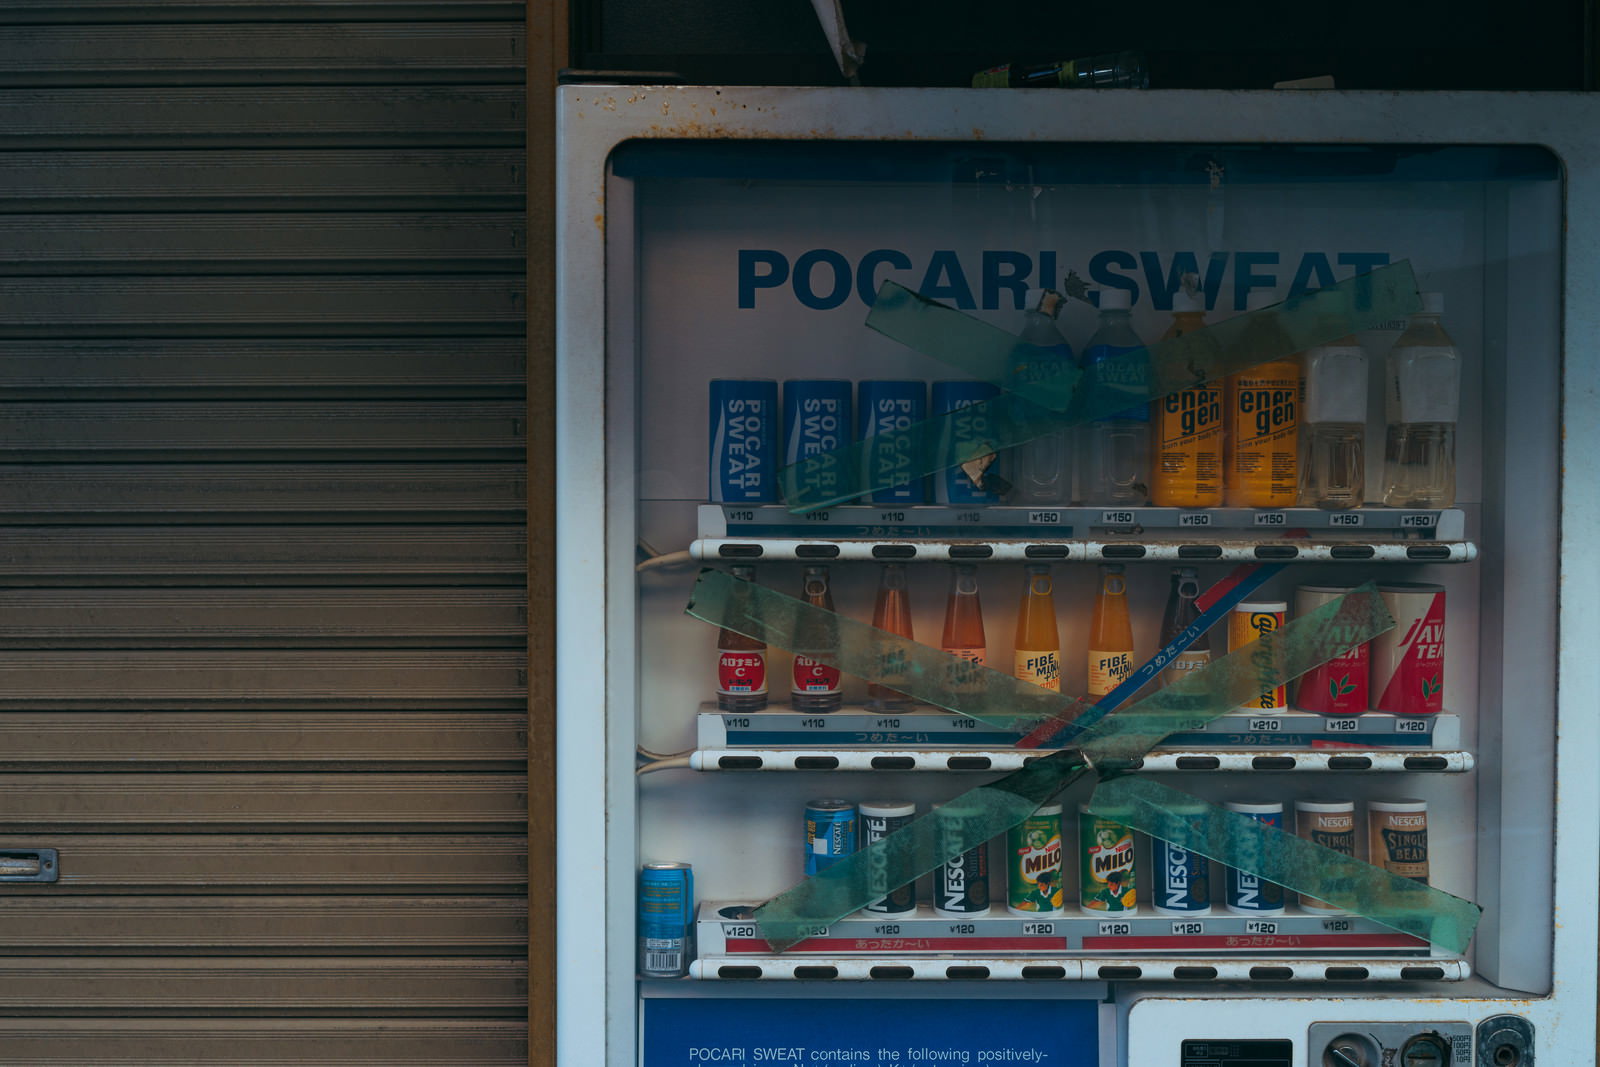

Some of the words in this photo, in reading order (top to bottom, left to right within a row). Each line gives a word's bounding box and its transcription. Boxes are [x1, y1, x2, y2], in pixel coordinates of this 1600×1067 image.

[738, 249, 1058, 311] POCARI
[1166, 391, 1217, 413] ener
[1240, 391, 1292, 413] ener
[1182, 402, 1219, 436] gen
[1256, 402, 1293, 436] gen
[728, 399, 745, 489] SWEAT
[745, 399, 761, 497] POCARI
[804, 398, 821, 489] SWEAT
[820, 398, 837, 497] POCARI
[879, 398, 896, 489] SWEAT
[895, 399, 912, 496] POCARI
[730, 511, 753, 521] ¥110
[806, 511, 829, 521] ¥110
[882, 512, 904, 522] ¥110
[1032, 512, 1058, 522] ¥150
[1106, 512, 1132, 522] ¥150
[1183, 515, 1208, 525] ¥150
[1257, 514, 1283, 524] ¥150
[1333, 515, 1359, 525] ¥150
[1027, 653, 1054, 670] FIBE
[1100, 653, 1127, 671] FIBE
[735, 667, 745, 677] C
[812, 667, 823, 676] C
[727, 718, 750, 728] ¥110
[802, 718, 825, 728] ¥110
[877, 719, 900, 729] ¥110
[952, 719, 975, 729] ¥110
[1253, 720, 1279, 730] ¥210
[1330, 720, 1356, 730] ¥120
[1400, 721, 1425, 731] ¥120
[1025, 848, 1061, 874] MILO
[1095, 847, 1133, 873] MILO
[875, 925, 900, 935] ¥120
[950, 925, 975, 934] ¥120
[1025, 924, 1052, 934] ¥120
[1101, 924, 1129, 935] ¥120
[1174, 923, 1202, 934] ¥120
[1248, 922, 1276, 934] ¥120
[1323, 921, 1349, 931] ¥120
[726, 927, 754, 937] ¥120
[689, 1047, 746, 1061] POCARI
[753, 1047, 806, 1061] SWEAT
[810, 1047, 871, 1061] contains
[878, 1047, 901, 1061] the
[908, 1047, 970, 1063] following
[977, 1047, 1049, 1063] positively-
